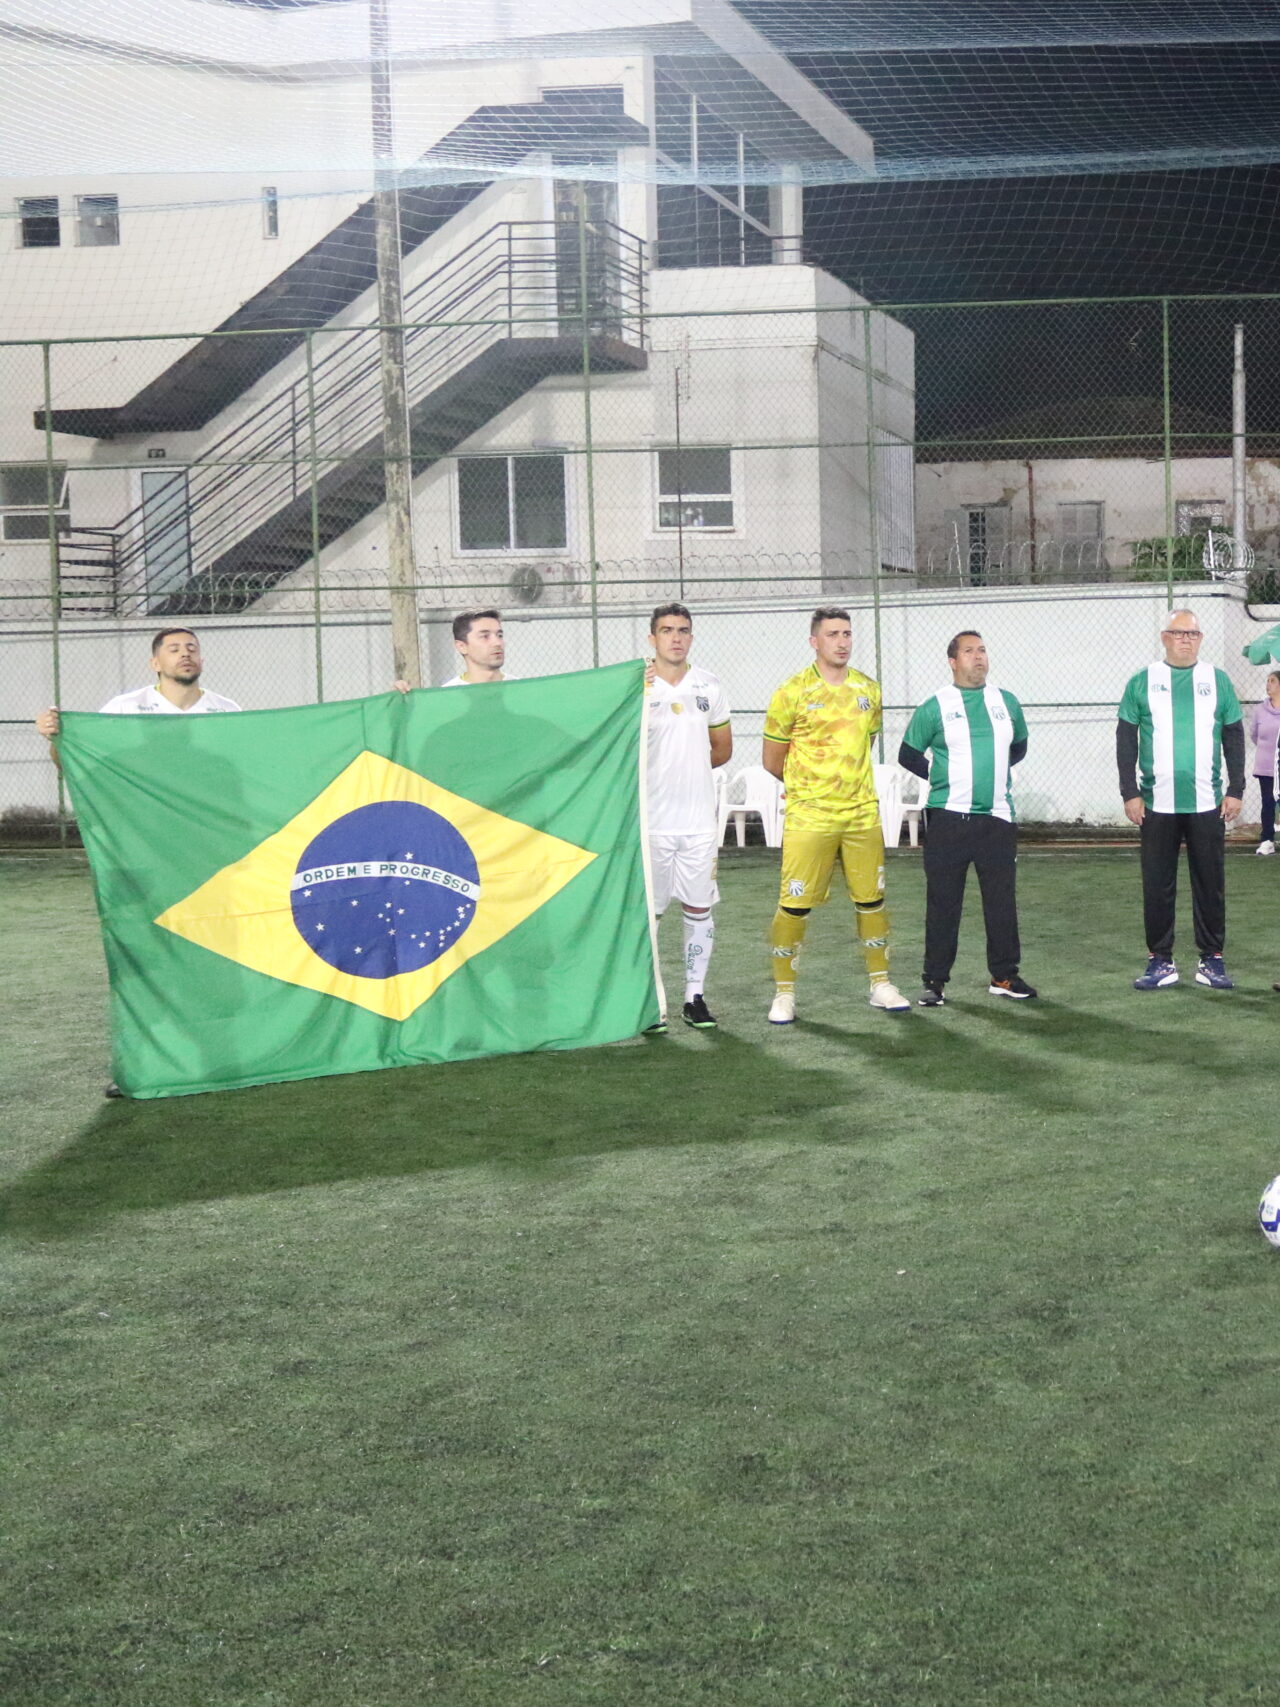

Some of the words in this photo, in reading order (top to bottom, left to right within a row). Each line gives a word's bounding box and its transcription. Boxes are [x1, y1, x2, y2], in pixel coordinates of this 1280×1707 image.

[303, 864, 357, 884] ORDEM
[363, 864, 372, 874] E
[379, 864, 470, 893] PROGRESSO
